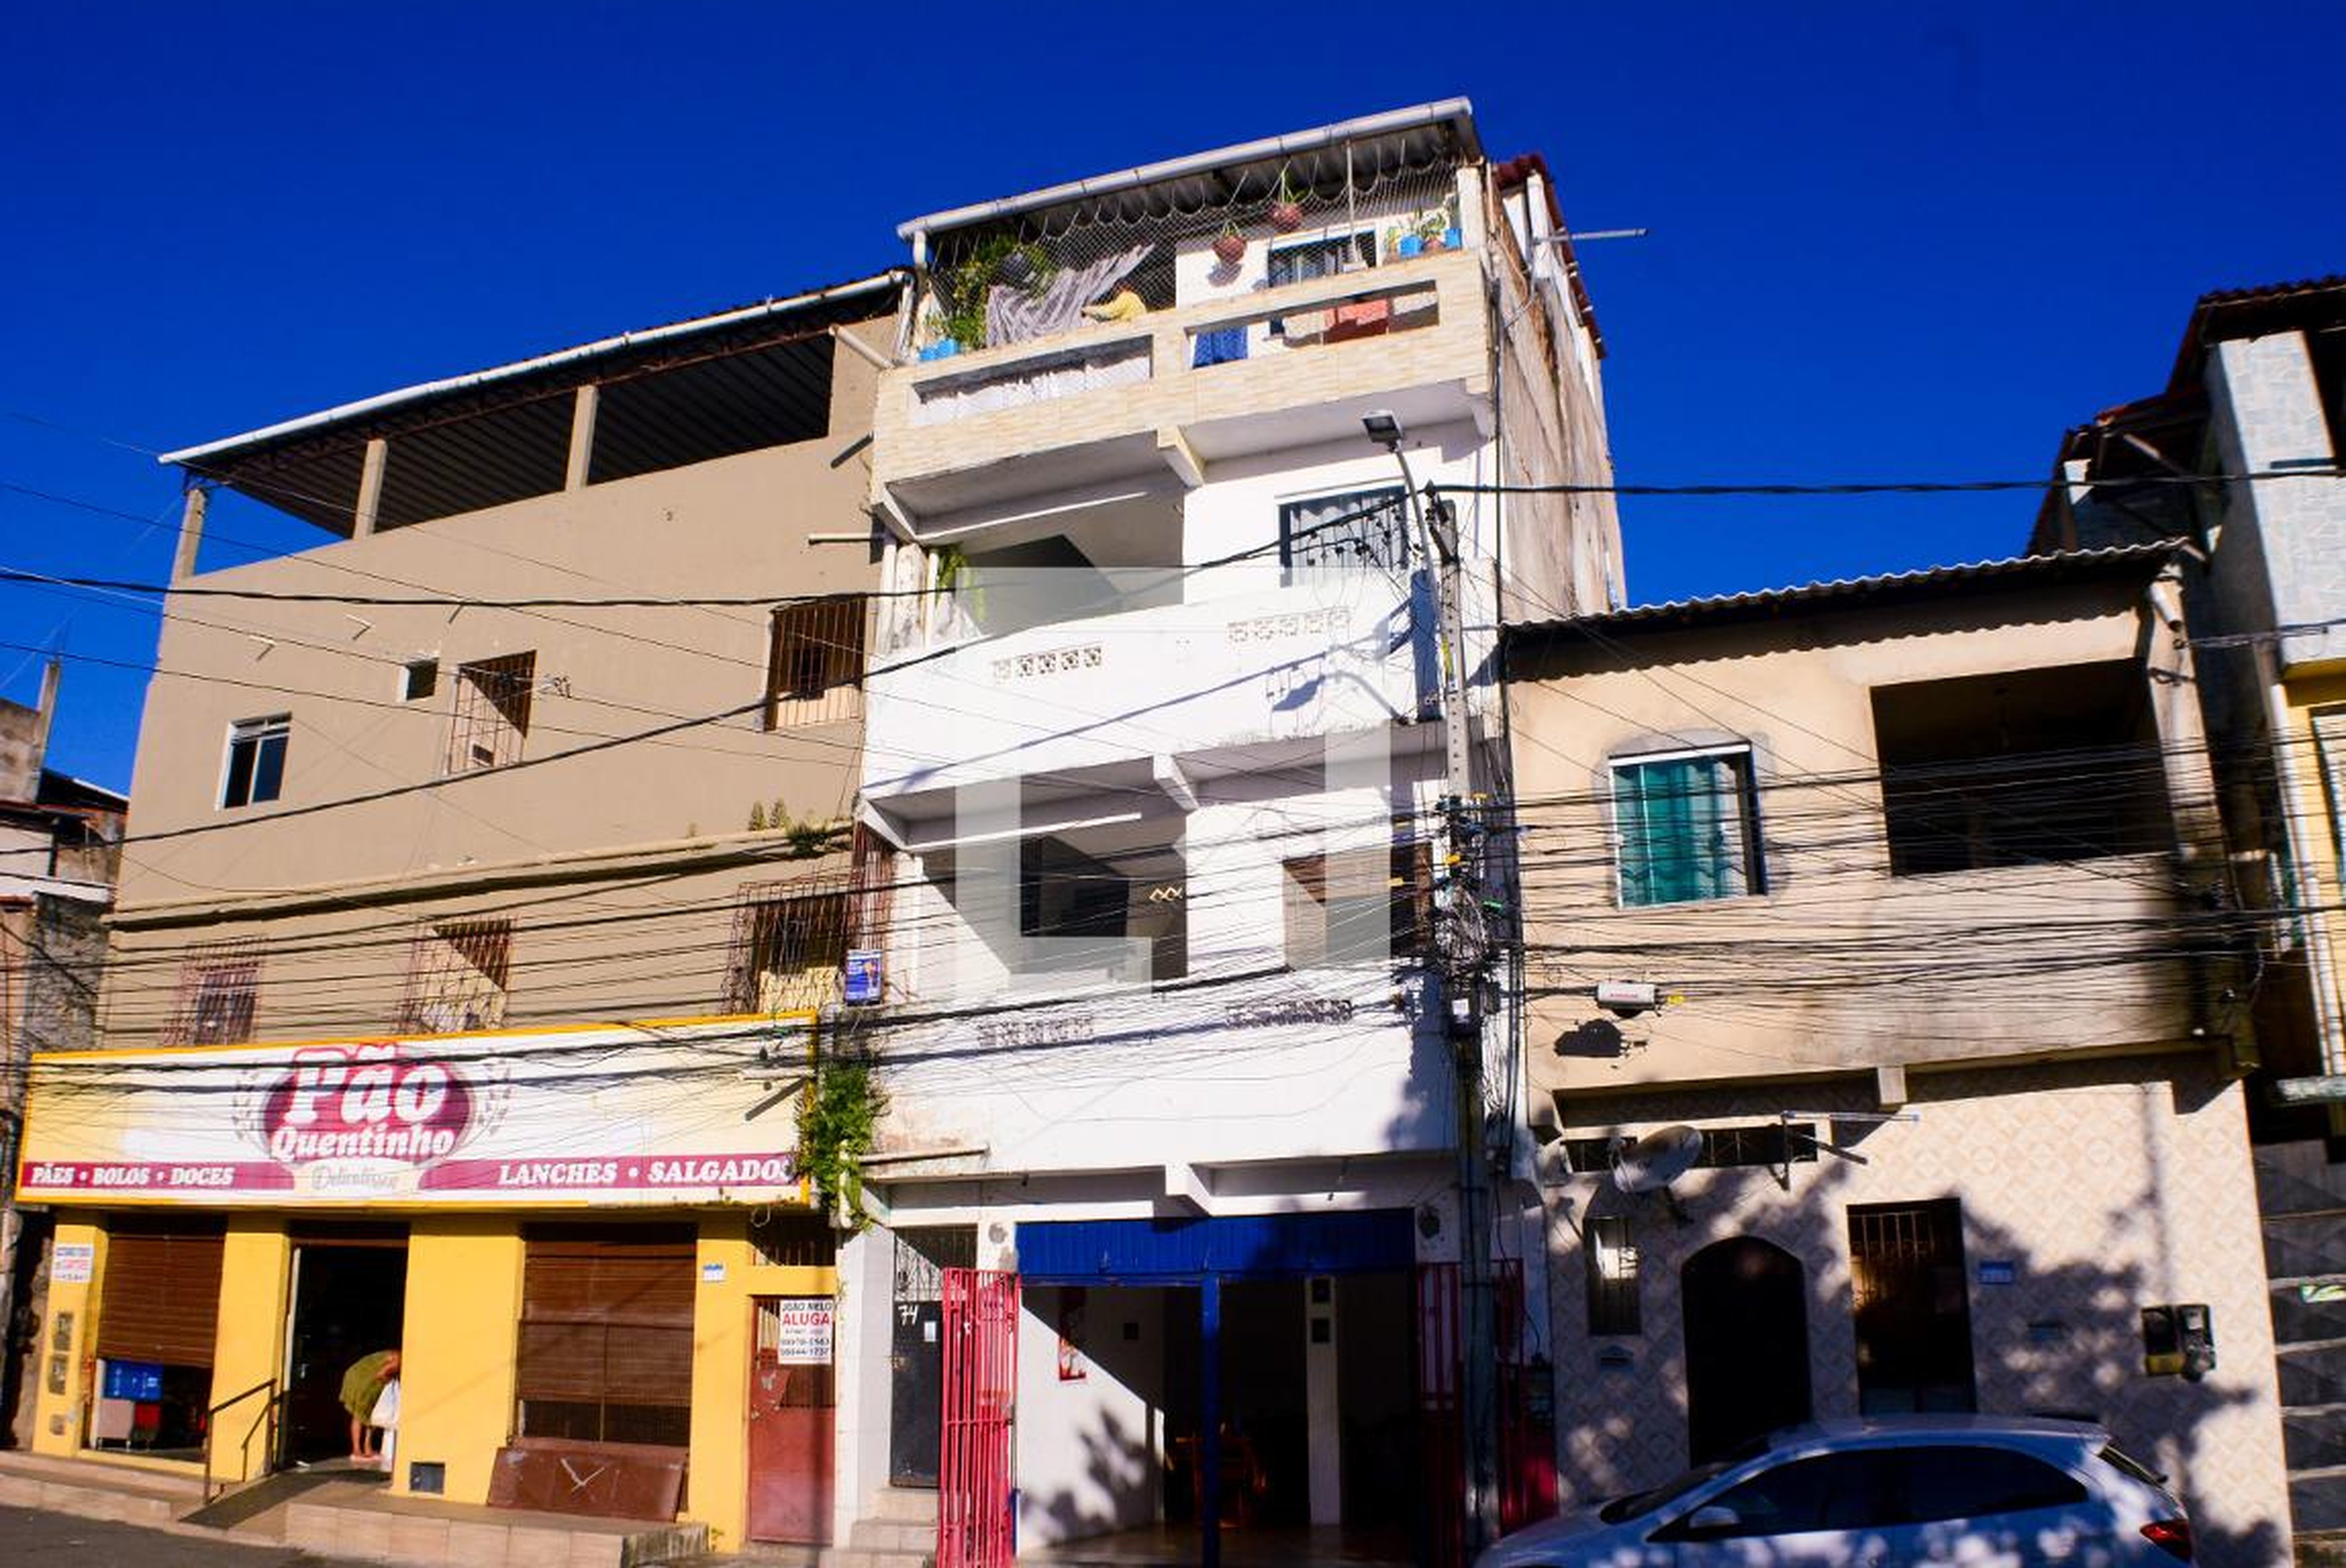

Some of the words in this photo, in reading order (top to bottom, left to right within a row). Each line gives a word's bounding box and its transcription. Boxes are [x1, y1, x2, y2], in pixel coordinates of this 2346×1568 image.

[284, 1044, 447, 1124] Pão
[271, 1123, 455, 1162] Quentinho
[31, 1162, 75, 1184] PÃES
[93, 1167, 150, 1185] BOLOS
[170, 1167, 235, 1185] DOCES
[498, 1162, 618, 1185] LANCHES
[783, 1312, 830, 1326] ALUGA
[898, 1305, 919, 1326] 74
